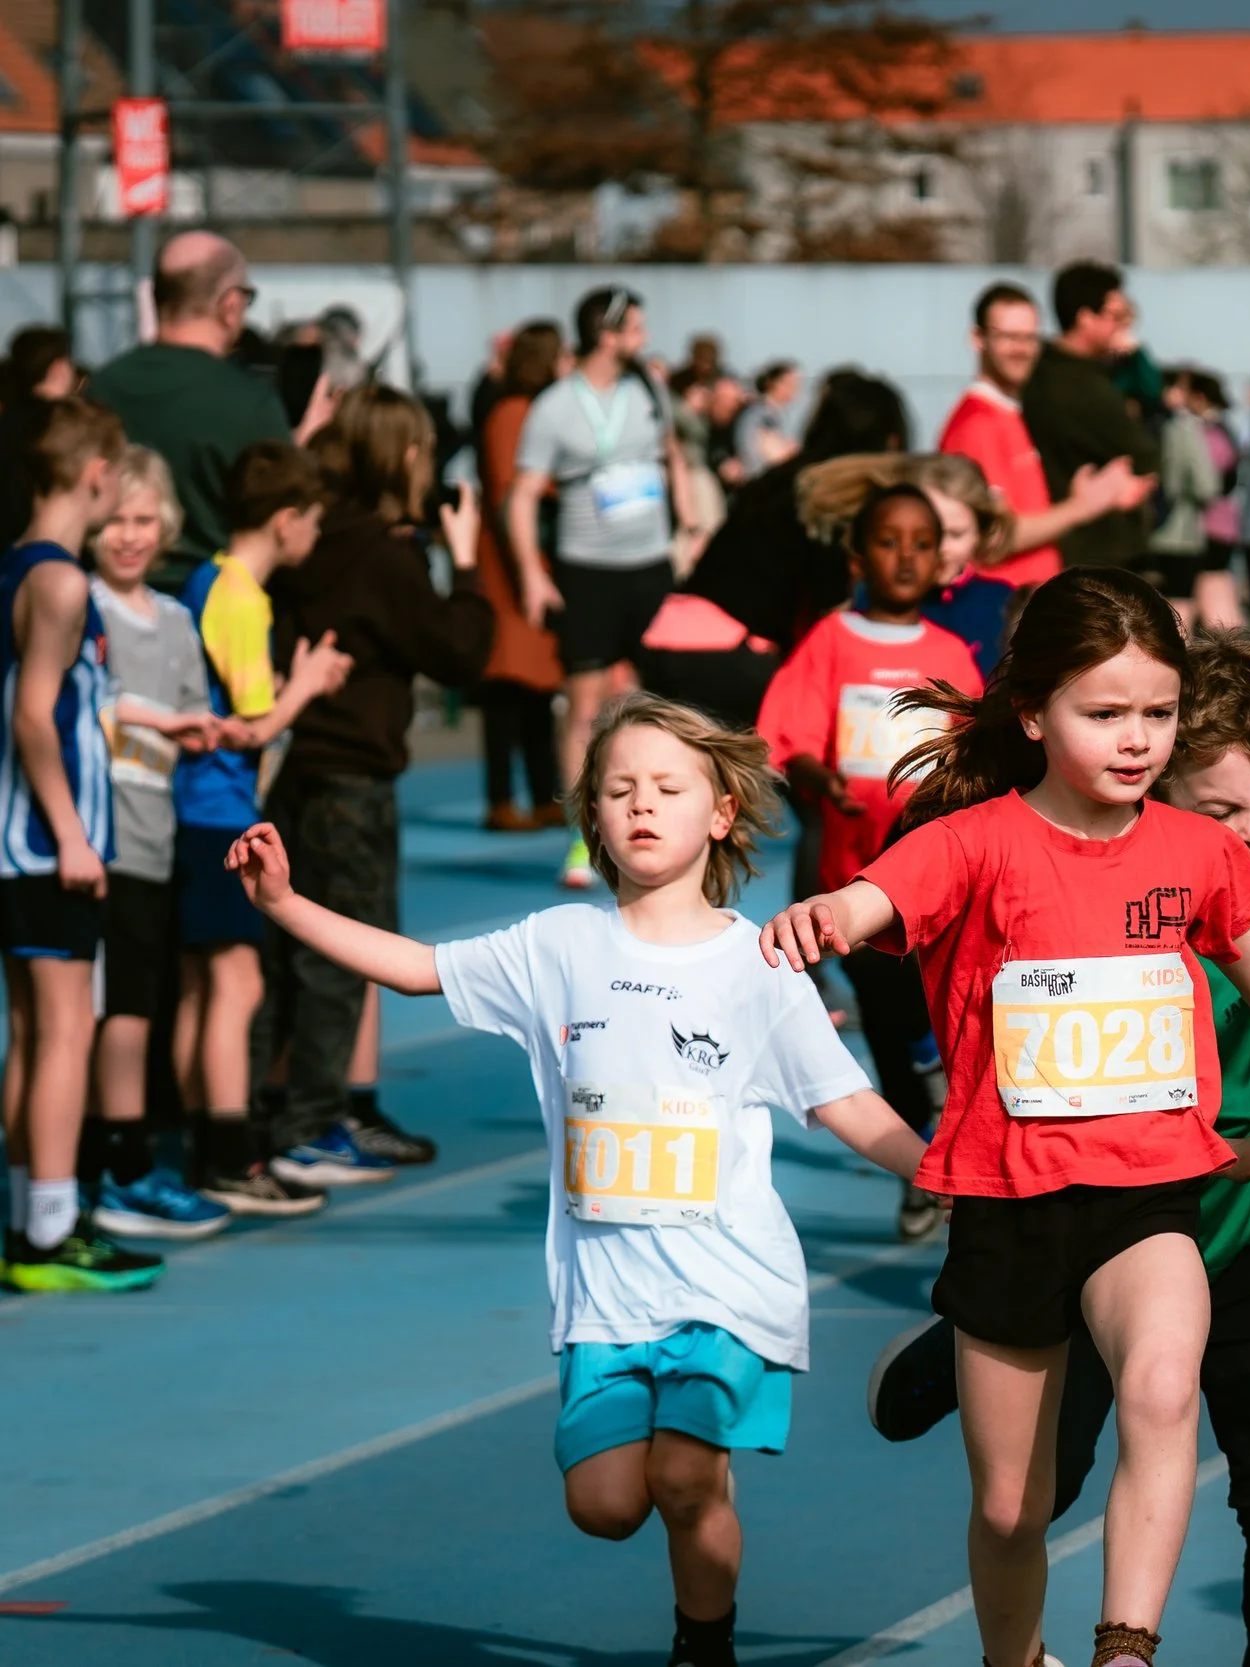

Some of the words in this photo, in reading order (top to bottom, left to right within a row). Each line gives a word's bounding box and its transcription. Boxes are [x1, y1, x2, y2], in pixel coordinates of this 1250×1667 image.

[1142, 967, 1185, 987] KIDS
[610, 980, 667, 996] CRAFT
[1006, 1005, 1186, 1081] 7028
[687, 1046, 721, 1069] KRC
[661, 1100, 709, 1116] KIDS
[566, 1127, 696, 1195] 7011
